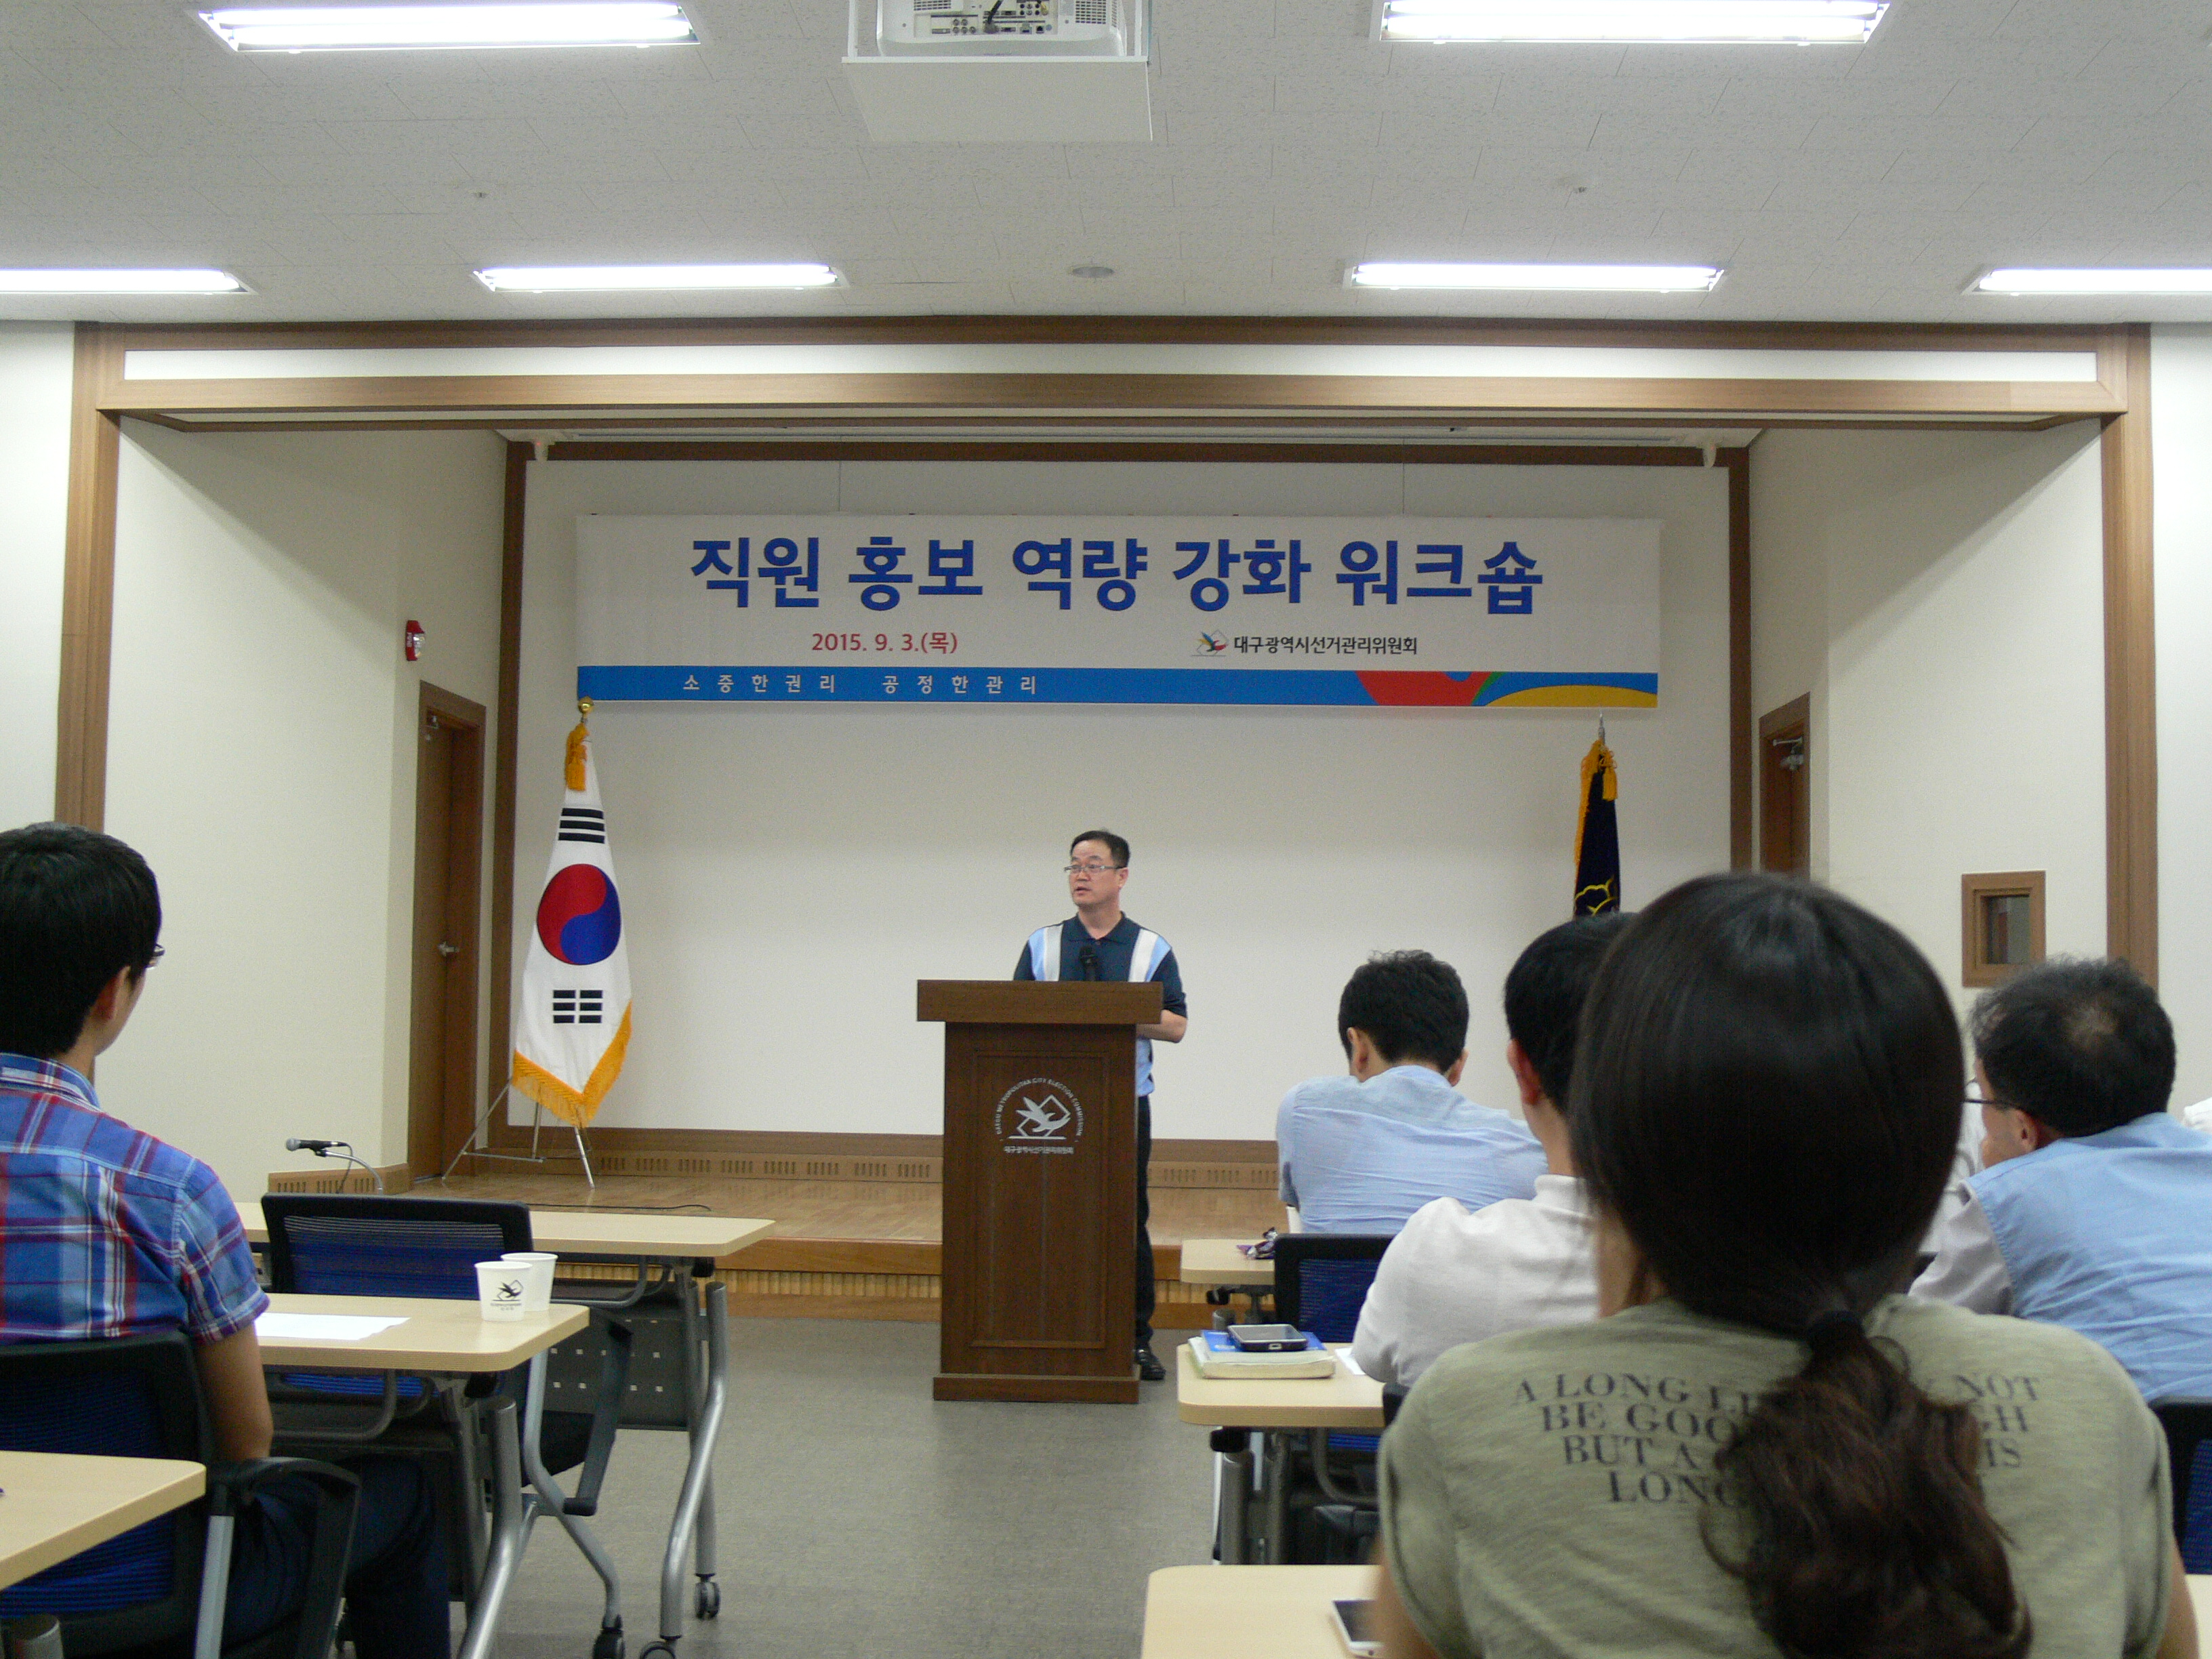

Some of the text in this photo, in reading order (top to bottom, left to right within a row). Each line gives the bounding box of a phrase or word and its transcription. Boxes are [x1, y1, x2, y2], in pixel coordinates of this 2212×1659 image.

[691, 536, 1544, 615] 직원 홍보 역량 강화 워크숍
[1233, 636, 1418, 655] 대구광역시선거관리위원회
[1511, 1378, 1537, 1406] A
[1555, 1372, 1690, 1404] LONG
[1954, 1373, 2040, 1401] NOT
[1541, 1400, 1742, 1444] BE GOO
[1561, 1433, 1654, 1467] BUT
[1674, 1441, 1701, 1470] A
